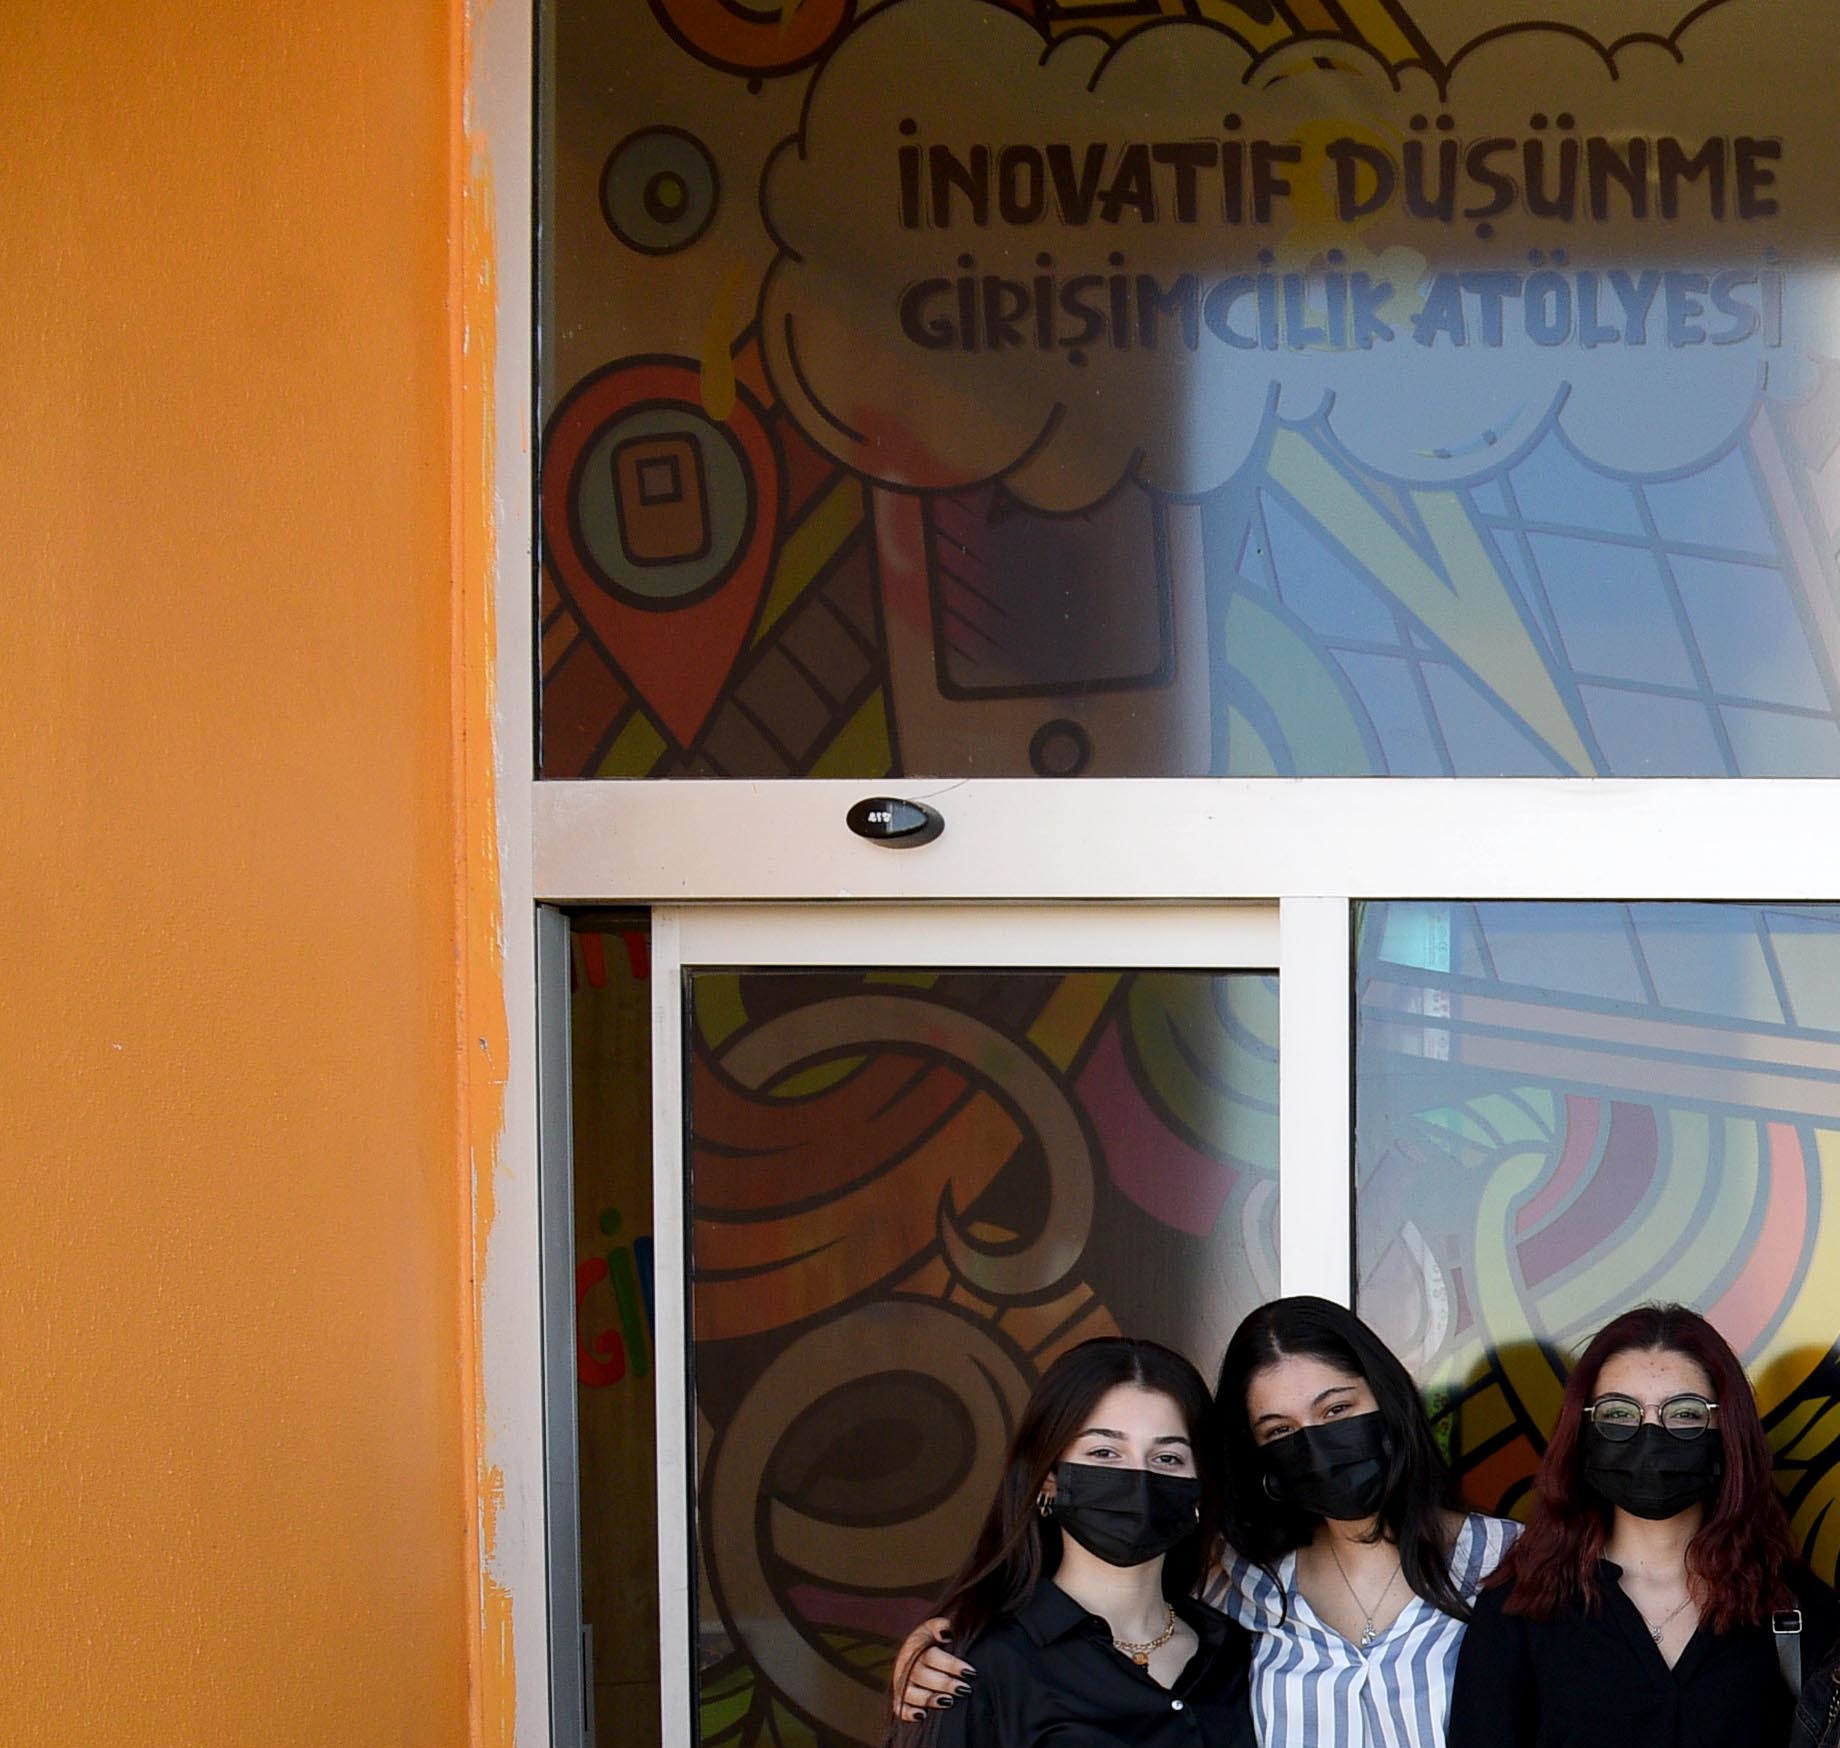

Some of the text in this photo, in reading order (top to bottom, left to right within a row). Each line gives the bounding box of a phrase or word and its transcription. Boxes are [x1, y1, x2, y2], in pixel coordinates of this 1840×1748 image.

[898, 113, 1784, 240] İNOVATİF DÜŞÜNME
[898, 248, 1784, 366] GİRİŞİMCİLİK ATÖLYESİ
